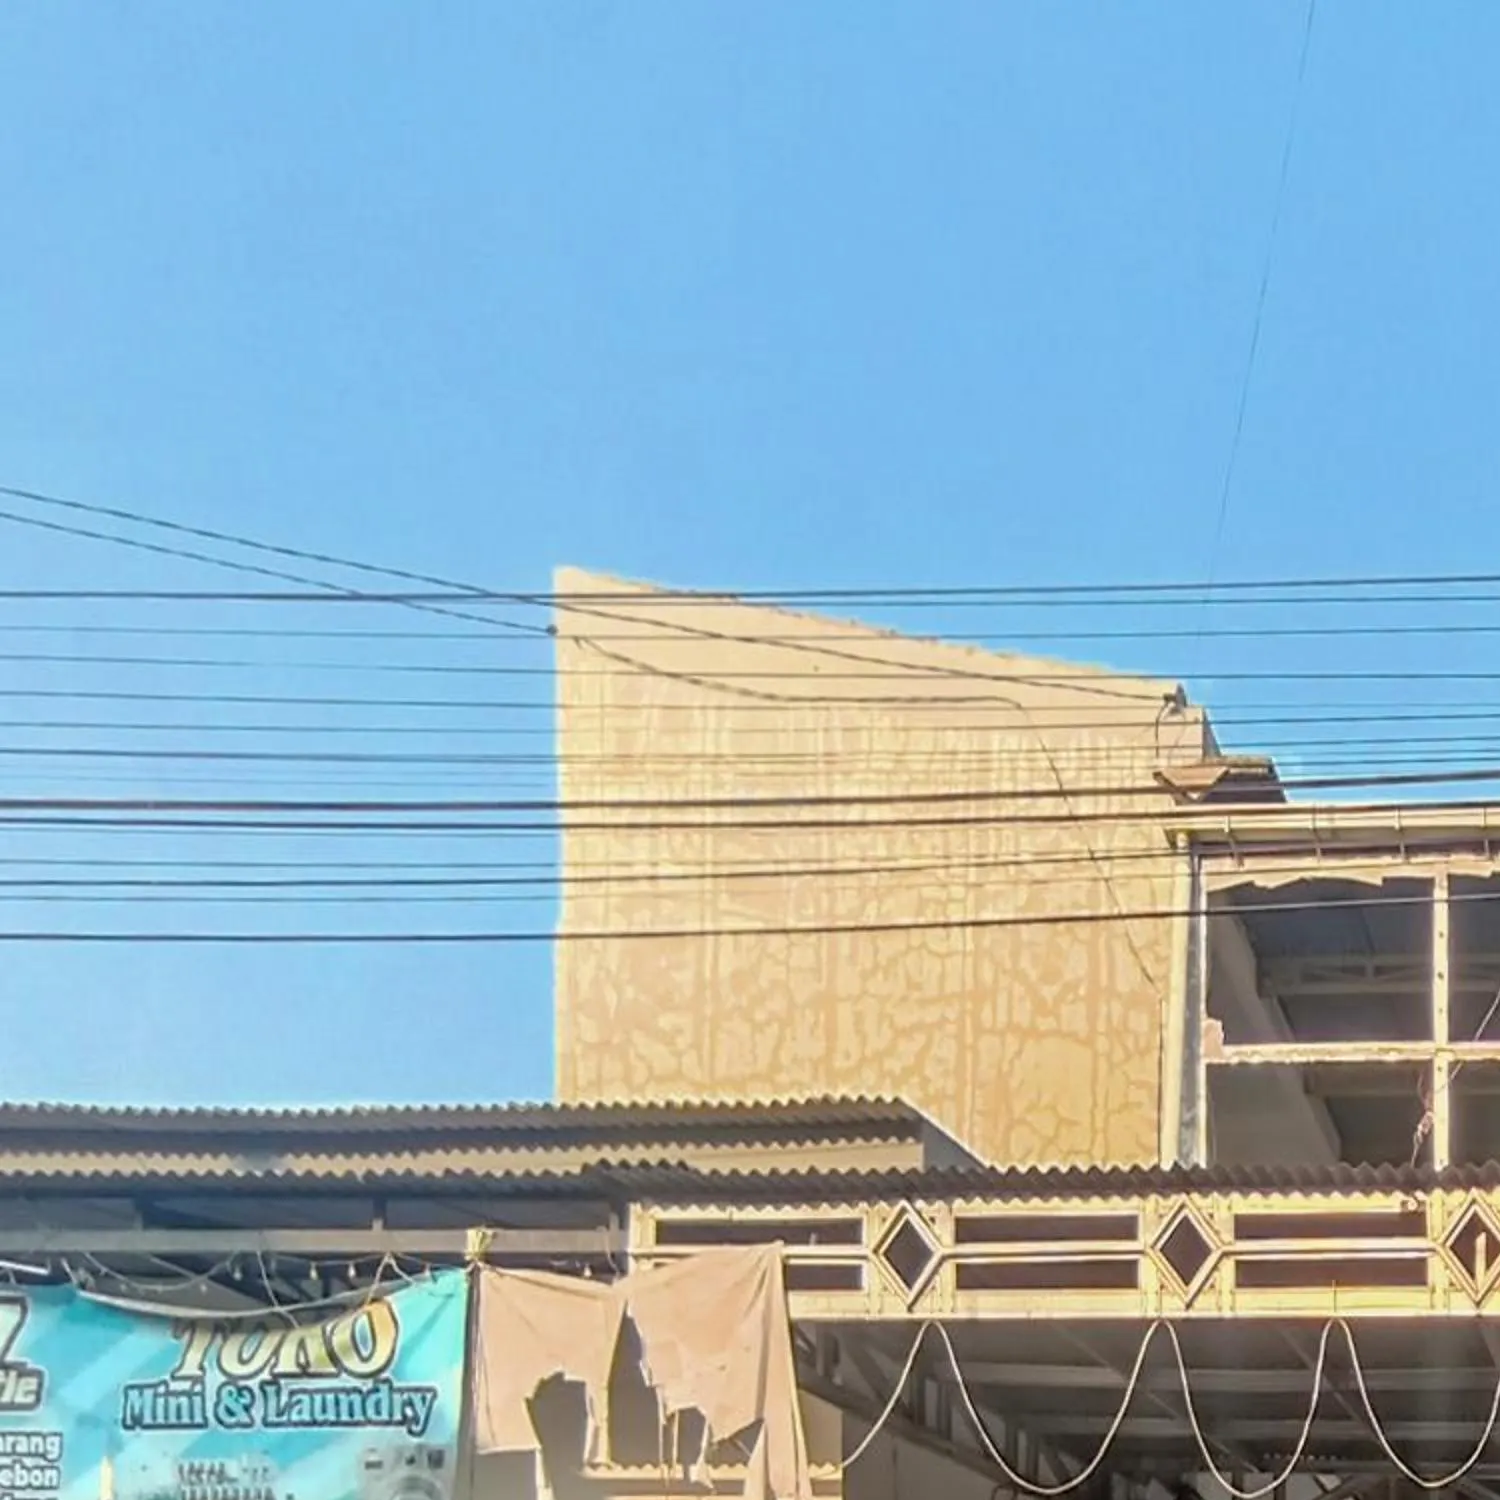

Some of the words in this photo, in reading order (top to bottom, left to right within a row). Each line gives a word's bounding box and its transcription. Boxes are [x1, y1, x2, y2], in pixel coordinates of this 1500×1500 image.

[122, 1383, 208, 1430] Mini
[213, 1381, 255, 1428] &
[259, 1377, 438, 1437] Laundry
